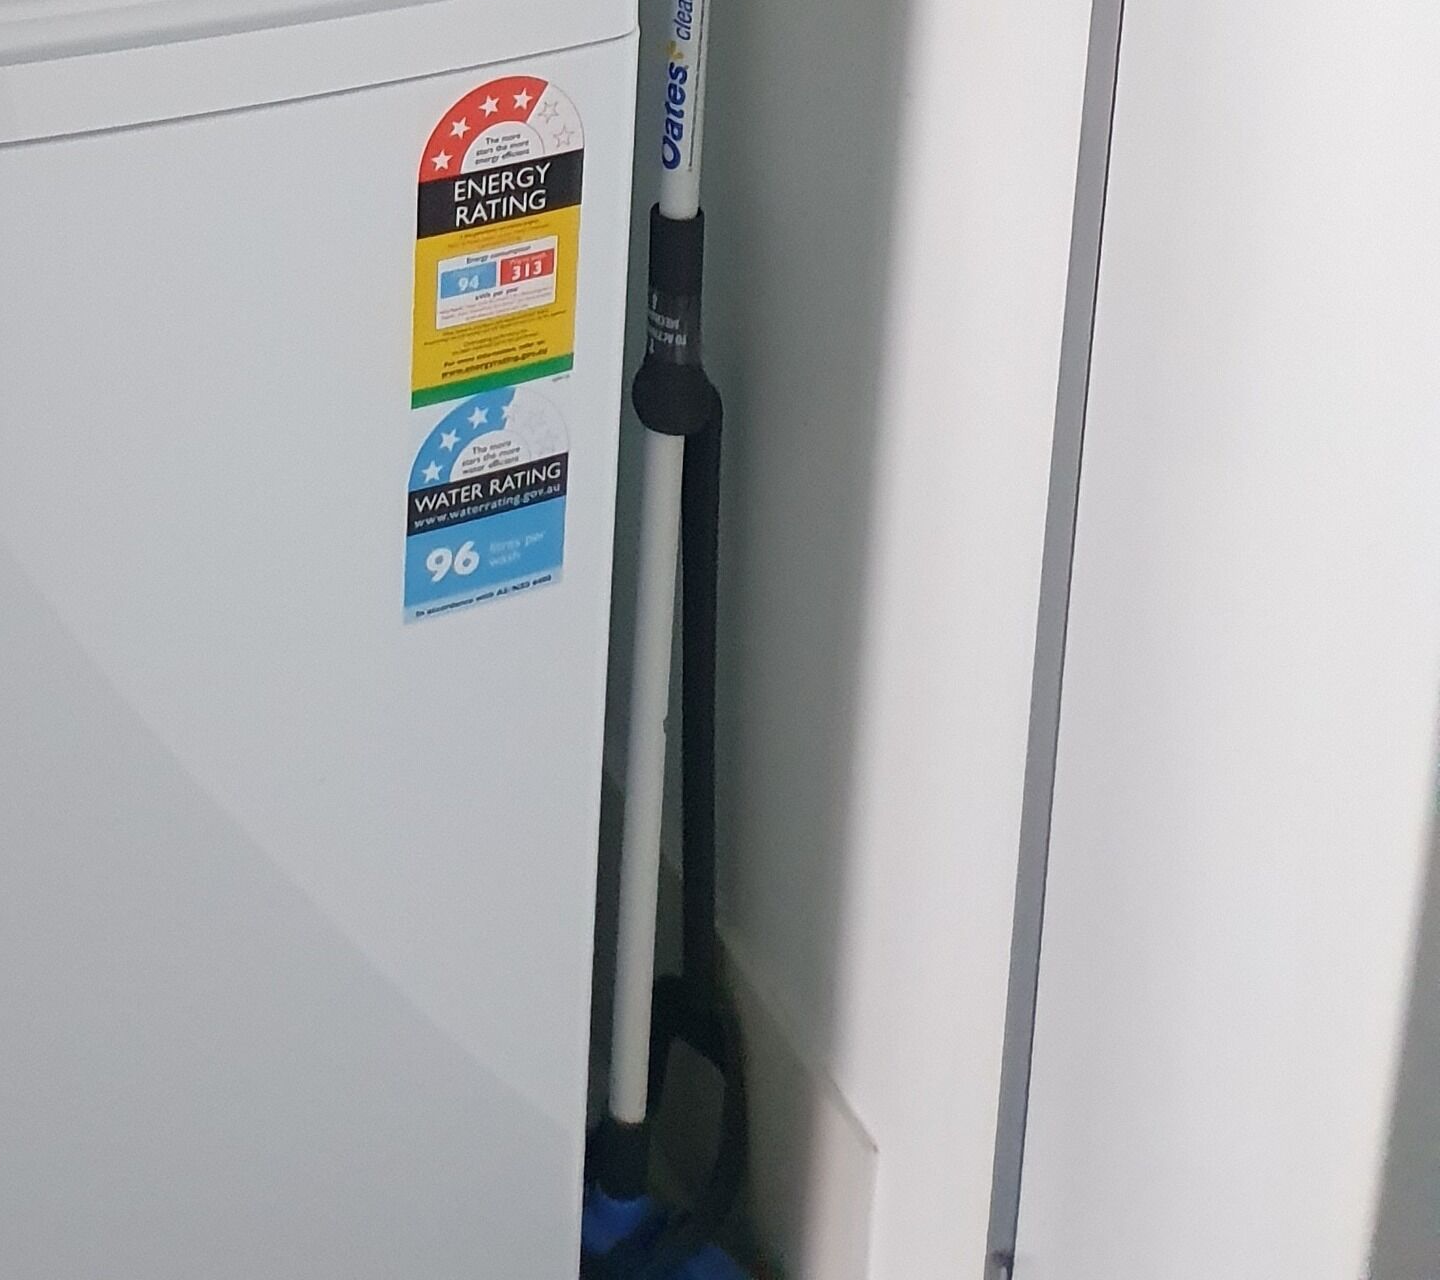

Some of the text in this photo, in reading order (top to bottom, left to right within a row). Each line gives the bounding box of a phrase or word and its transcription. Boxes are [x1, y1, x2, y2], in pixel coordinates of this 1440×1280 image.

[661, 62, 689, 170] Oates
[453, 162, 551, 203] ENERGY
[455, 189, 547, 228] RATING
[458, 258, 543, 291] 94 313
[413, 483, 561, 529] www.waterrating.gov.au
[414, 461, 562, 514] WATER RATING
[425, 540, 480, 583] 96
